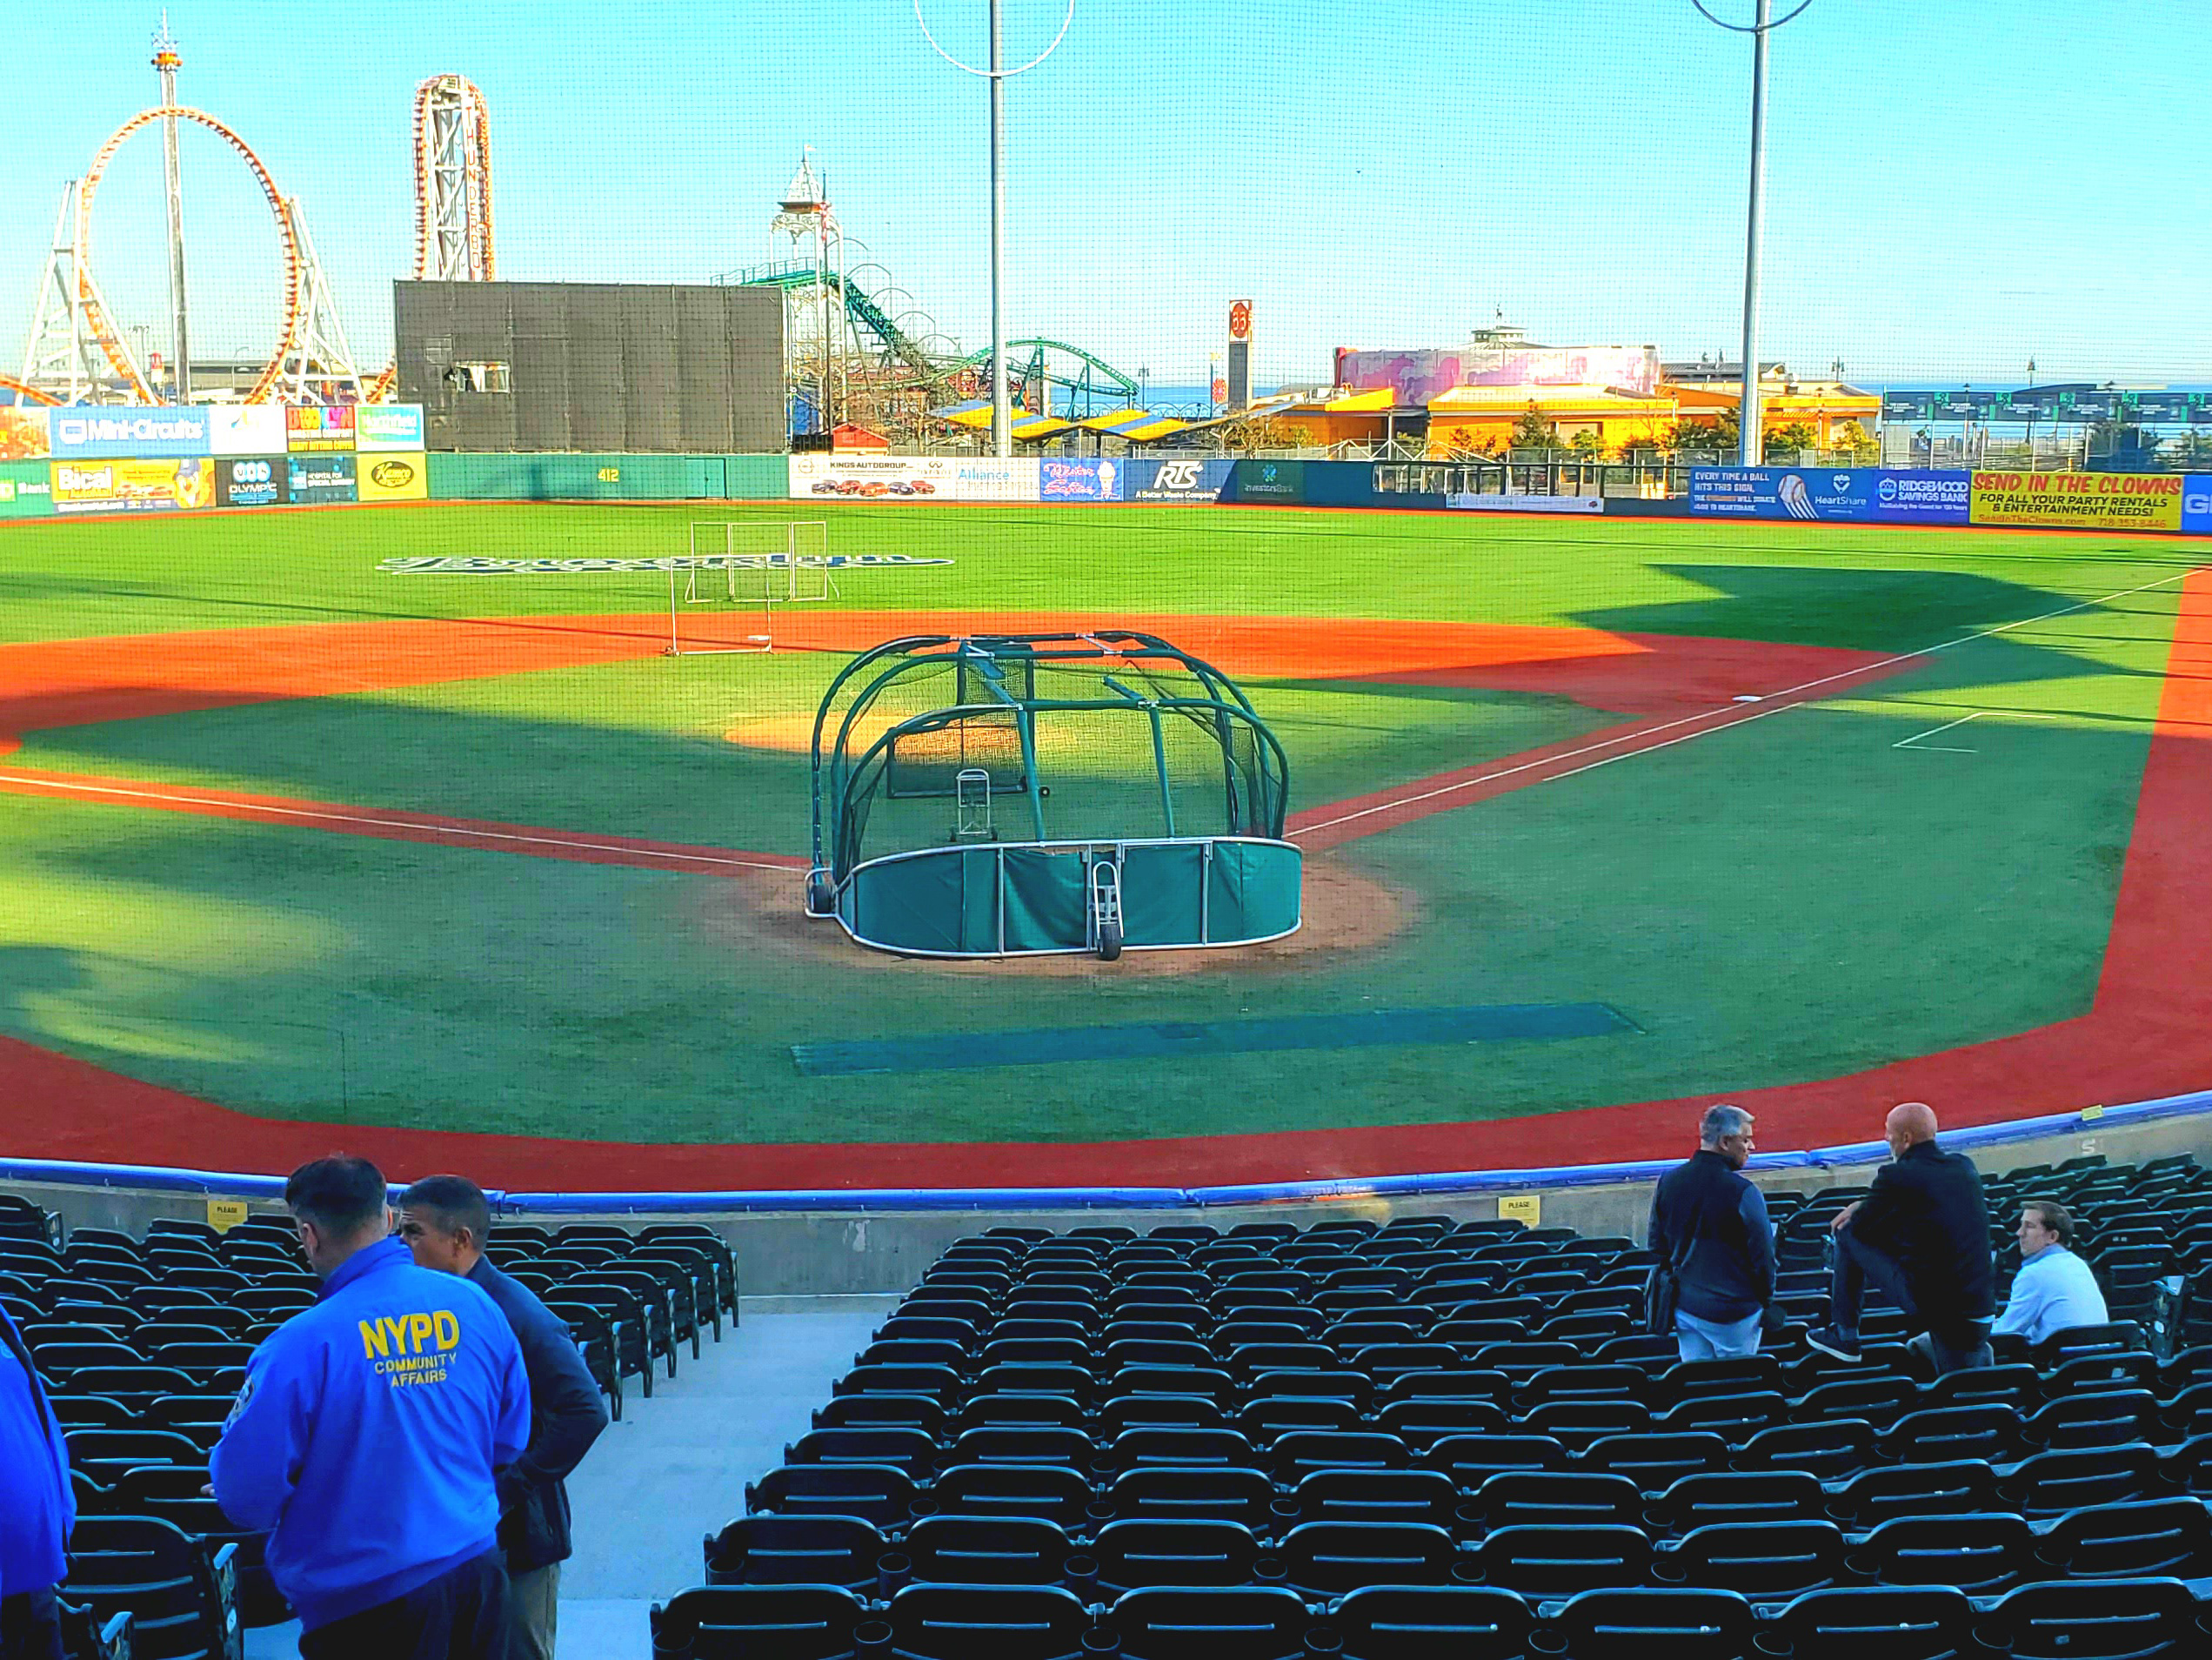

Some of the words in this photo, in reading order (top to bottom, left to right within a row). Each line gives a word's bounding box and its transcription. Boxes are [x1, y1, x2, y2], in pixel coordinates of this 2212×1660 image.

[88, 419, 204, 440] Mini-Circuits
[57, 465, 112, 492] Bical
[598, 468, 619, 482] 412
[959, 467, 1010, 480] Alliance
[1153, 460, 1204, 489] RTS
[1694, 472, 1720, 480] EVERY
[1749, 472, 1769, 481] BALL
[1714, 483, 1732, 492] THIS
[1898, 480, 1968, 492] RIDGEWOOD
[1974, 472, 2022, 491] SEND
[2028, 475, 2049, 492] IN
[2055, 475, 2093, 492] THE
[2098, 476, 2182, 495] CLOWNS
[1814, 496, 1867, 505] HeartShare
[1898, 492, 1939, 502] SAVINGS
[1940, 493, 1968, 503] BANK
[1979, 493, 2004, 502] FOR
[2006, 494, 2028, 503] ALL
[2032, 495, 2065, 504] YOUR
[2067, 496, 2108, 505] PARTY
[2110, 498, 2168, 507] RENTALS
[2184, 493, 2212, 513] G
[1992, 503, 2001, 512] &
[2003, 504, 2106, 515] ENTERTAINMENT
[2108, 507, 2154, 517] NEEDS!
[358, 1309, 460, 1360] NYPD
[374, 1352, 457, 1375] COMMUNITY
[391, 1369, 447, 1387] AFFAIRS
